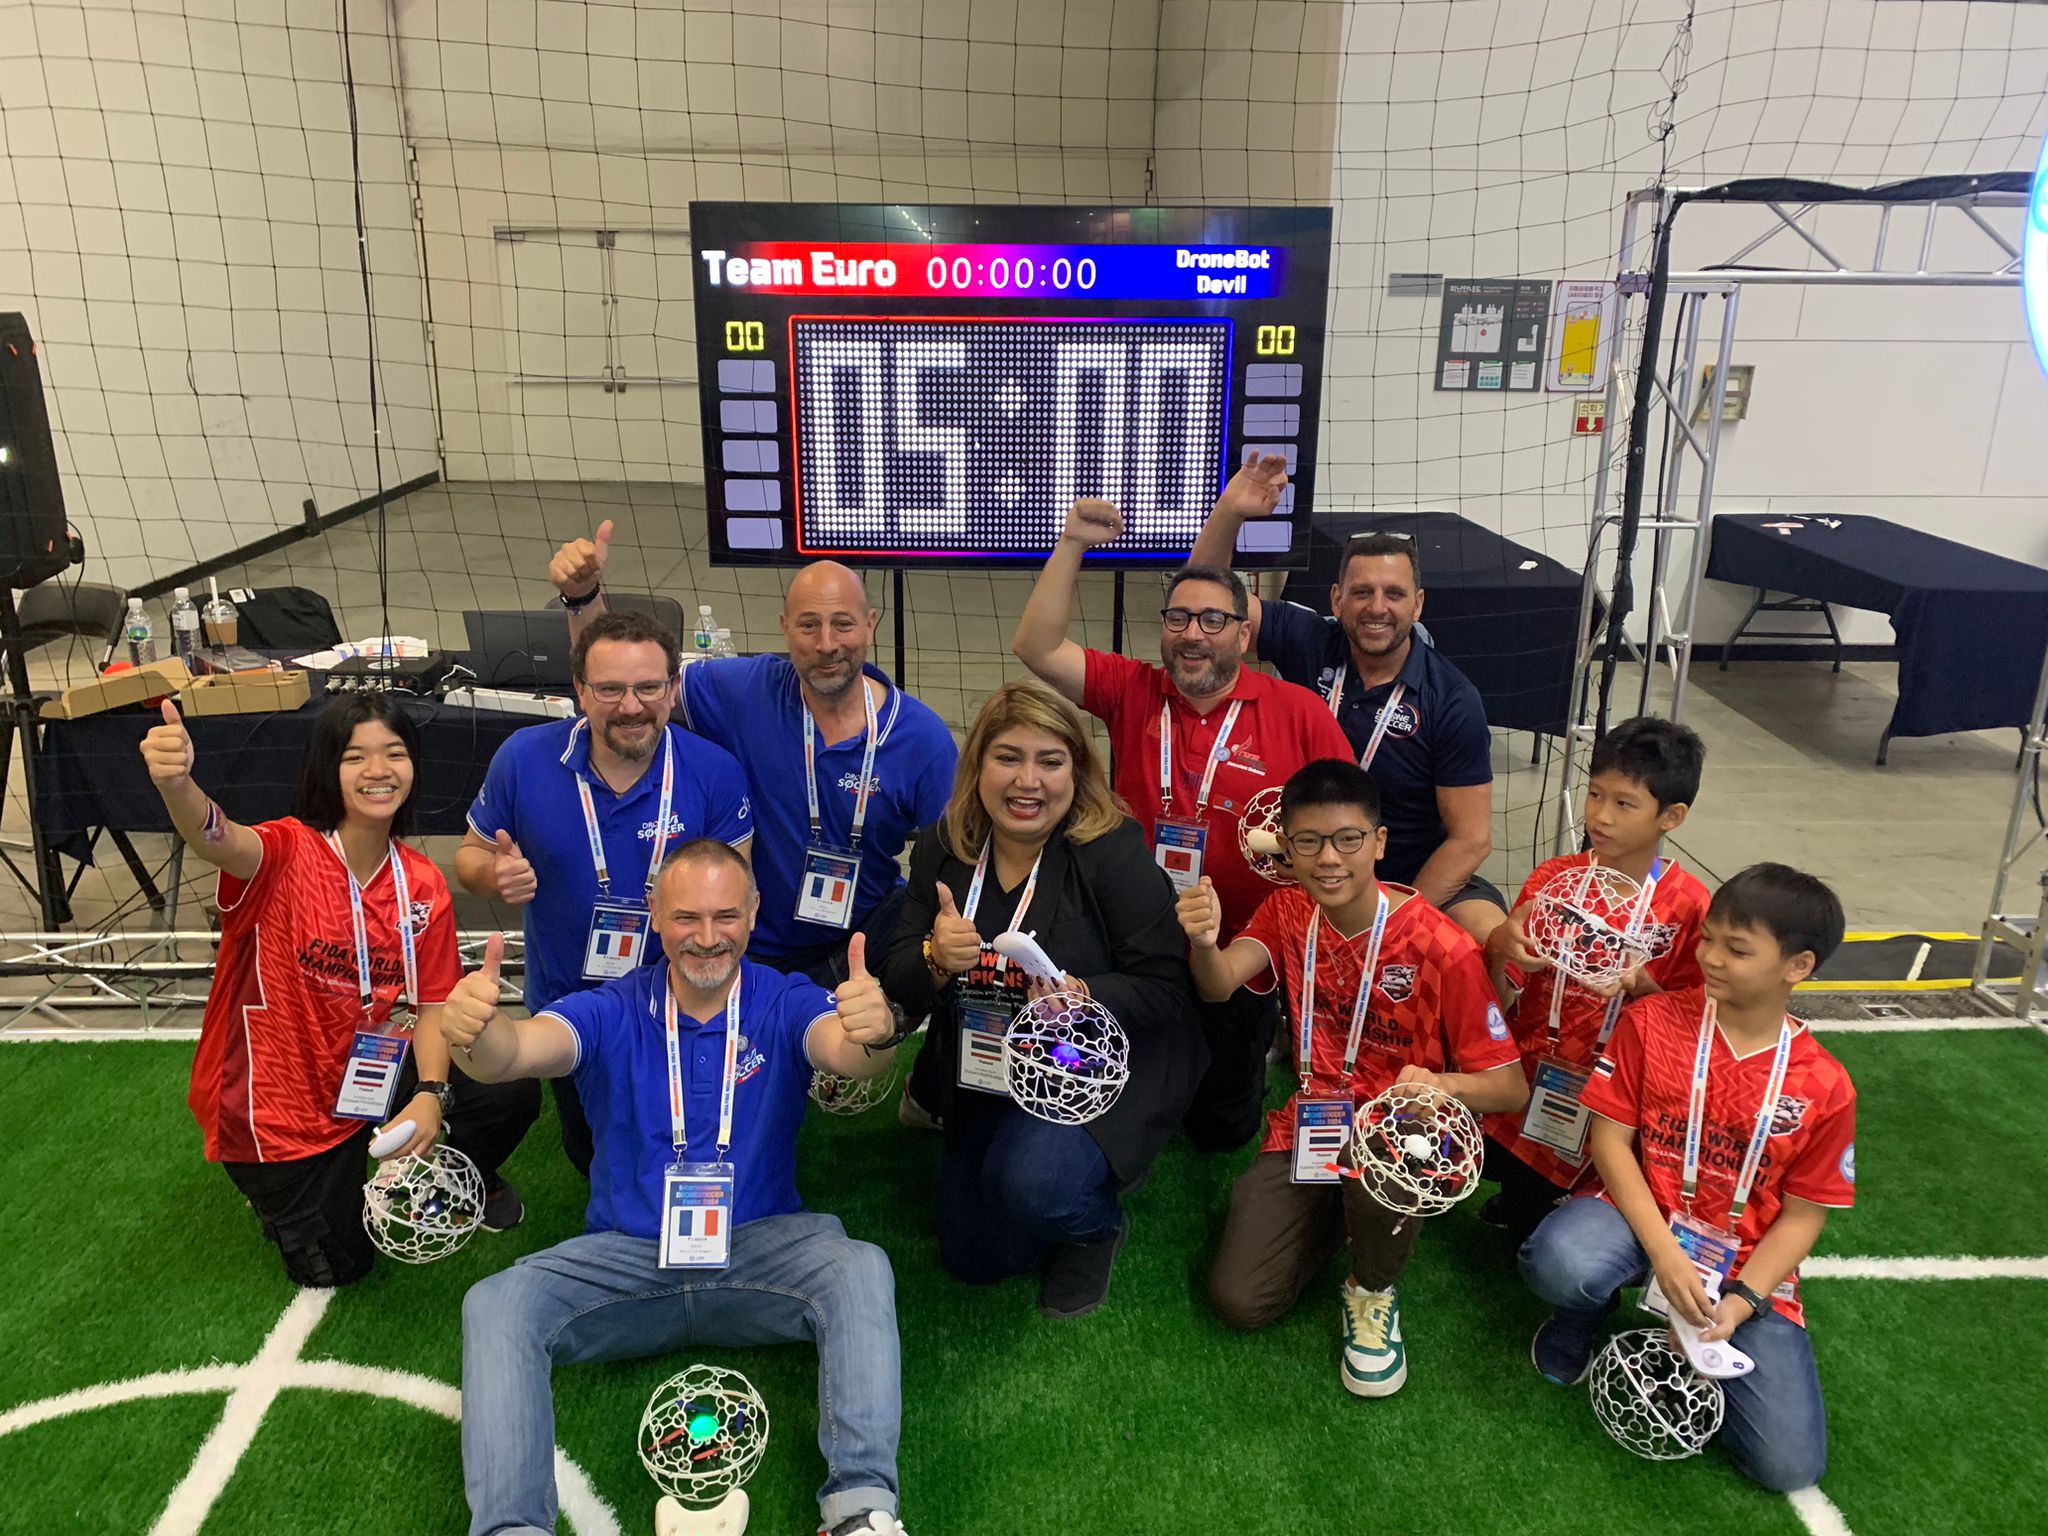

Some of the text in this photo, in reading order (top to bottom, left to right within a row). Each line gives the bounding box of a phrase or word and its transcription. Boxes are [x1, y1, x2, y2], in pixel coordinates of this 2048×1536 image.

[701, 250, 896, 286] Team Euro
[927, 256, 1097, 290] 00:00:00
[1176, 249, 1270, 269] DroneBot
[1196, 275, 1247, 294] Devil
[725, 321, 764, 352] 00
[1257, 325, 1296, 355] 00
[811, 340, 1211, 534] 05:00
[1374, 714, 1413, 732] SCCER
[637, 823, 686, 842] SOER
[1338, 1003, 1399, 1031] WRLD
[1707, 1130, 1772, 1168] WORD
